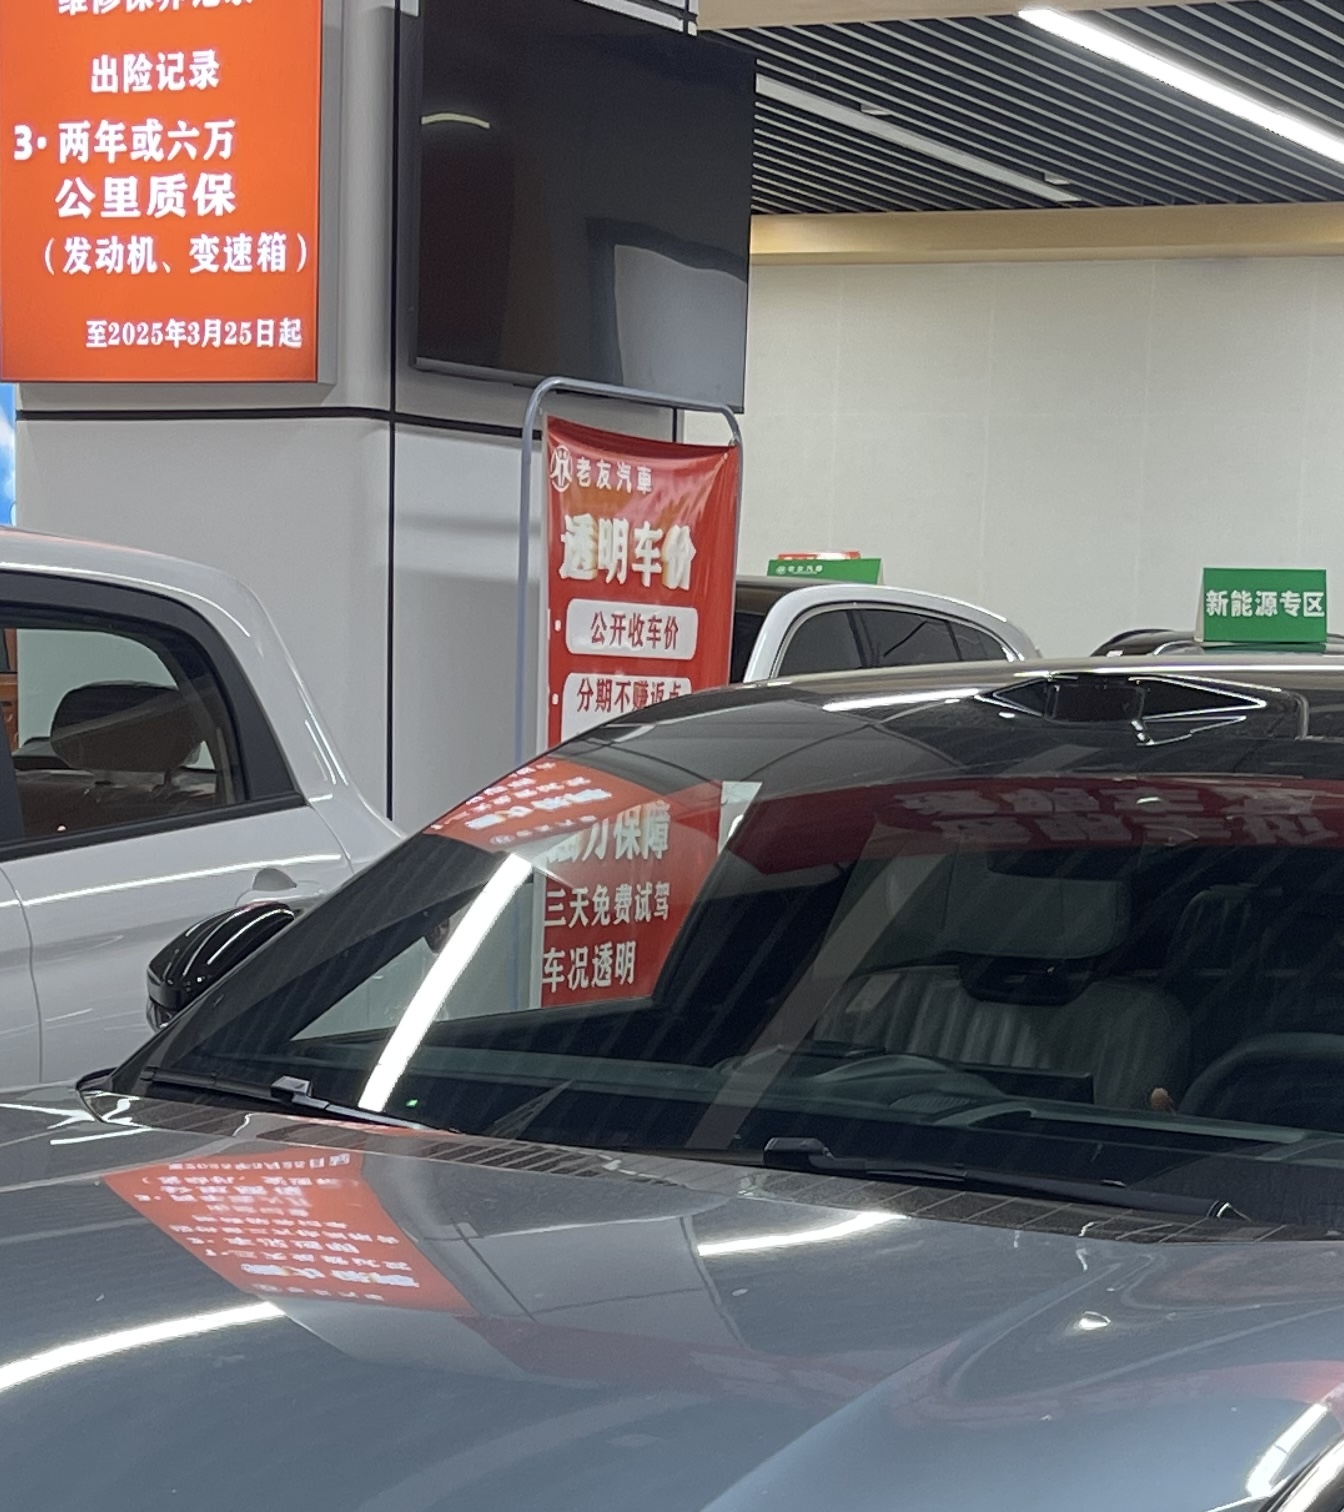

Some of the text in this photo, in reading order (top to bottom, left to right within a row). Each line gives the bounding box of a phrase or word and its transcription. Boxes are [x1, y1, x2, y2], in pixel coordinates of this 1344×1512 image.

[90, 48, 221, 94] 出险记录
[55, 171, 237, 219] 公里质保
[85, 317, 304, 349] 至2025年3月25日起
[558, 512, 698, 592] 透明车价
[1205, 589, 1326, 618] 新能源专区
[590, 611, 680, 651] 公开收车价
[543, 880, 671, 929] 三天免费试驾
[542, 940, 637, 994] 车况透明
